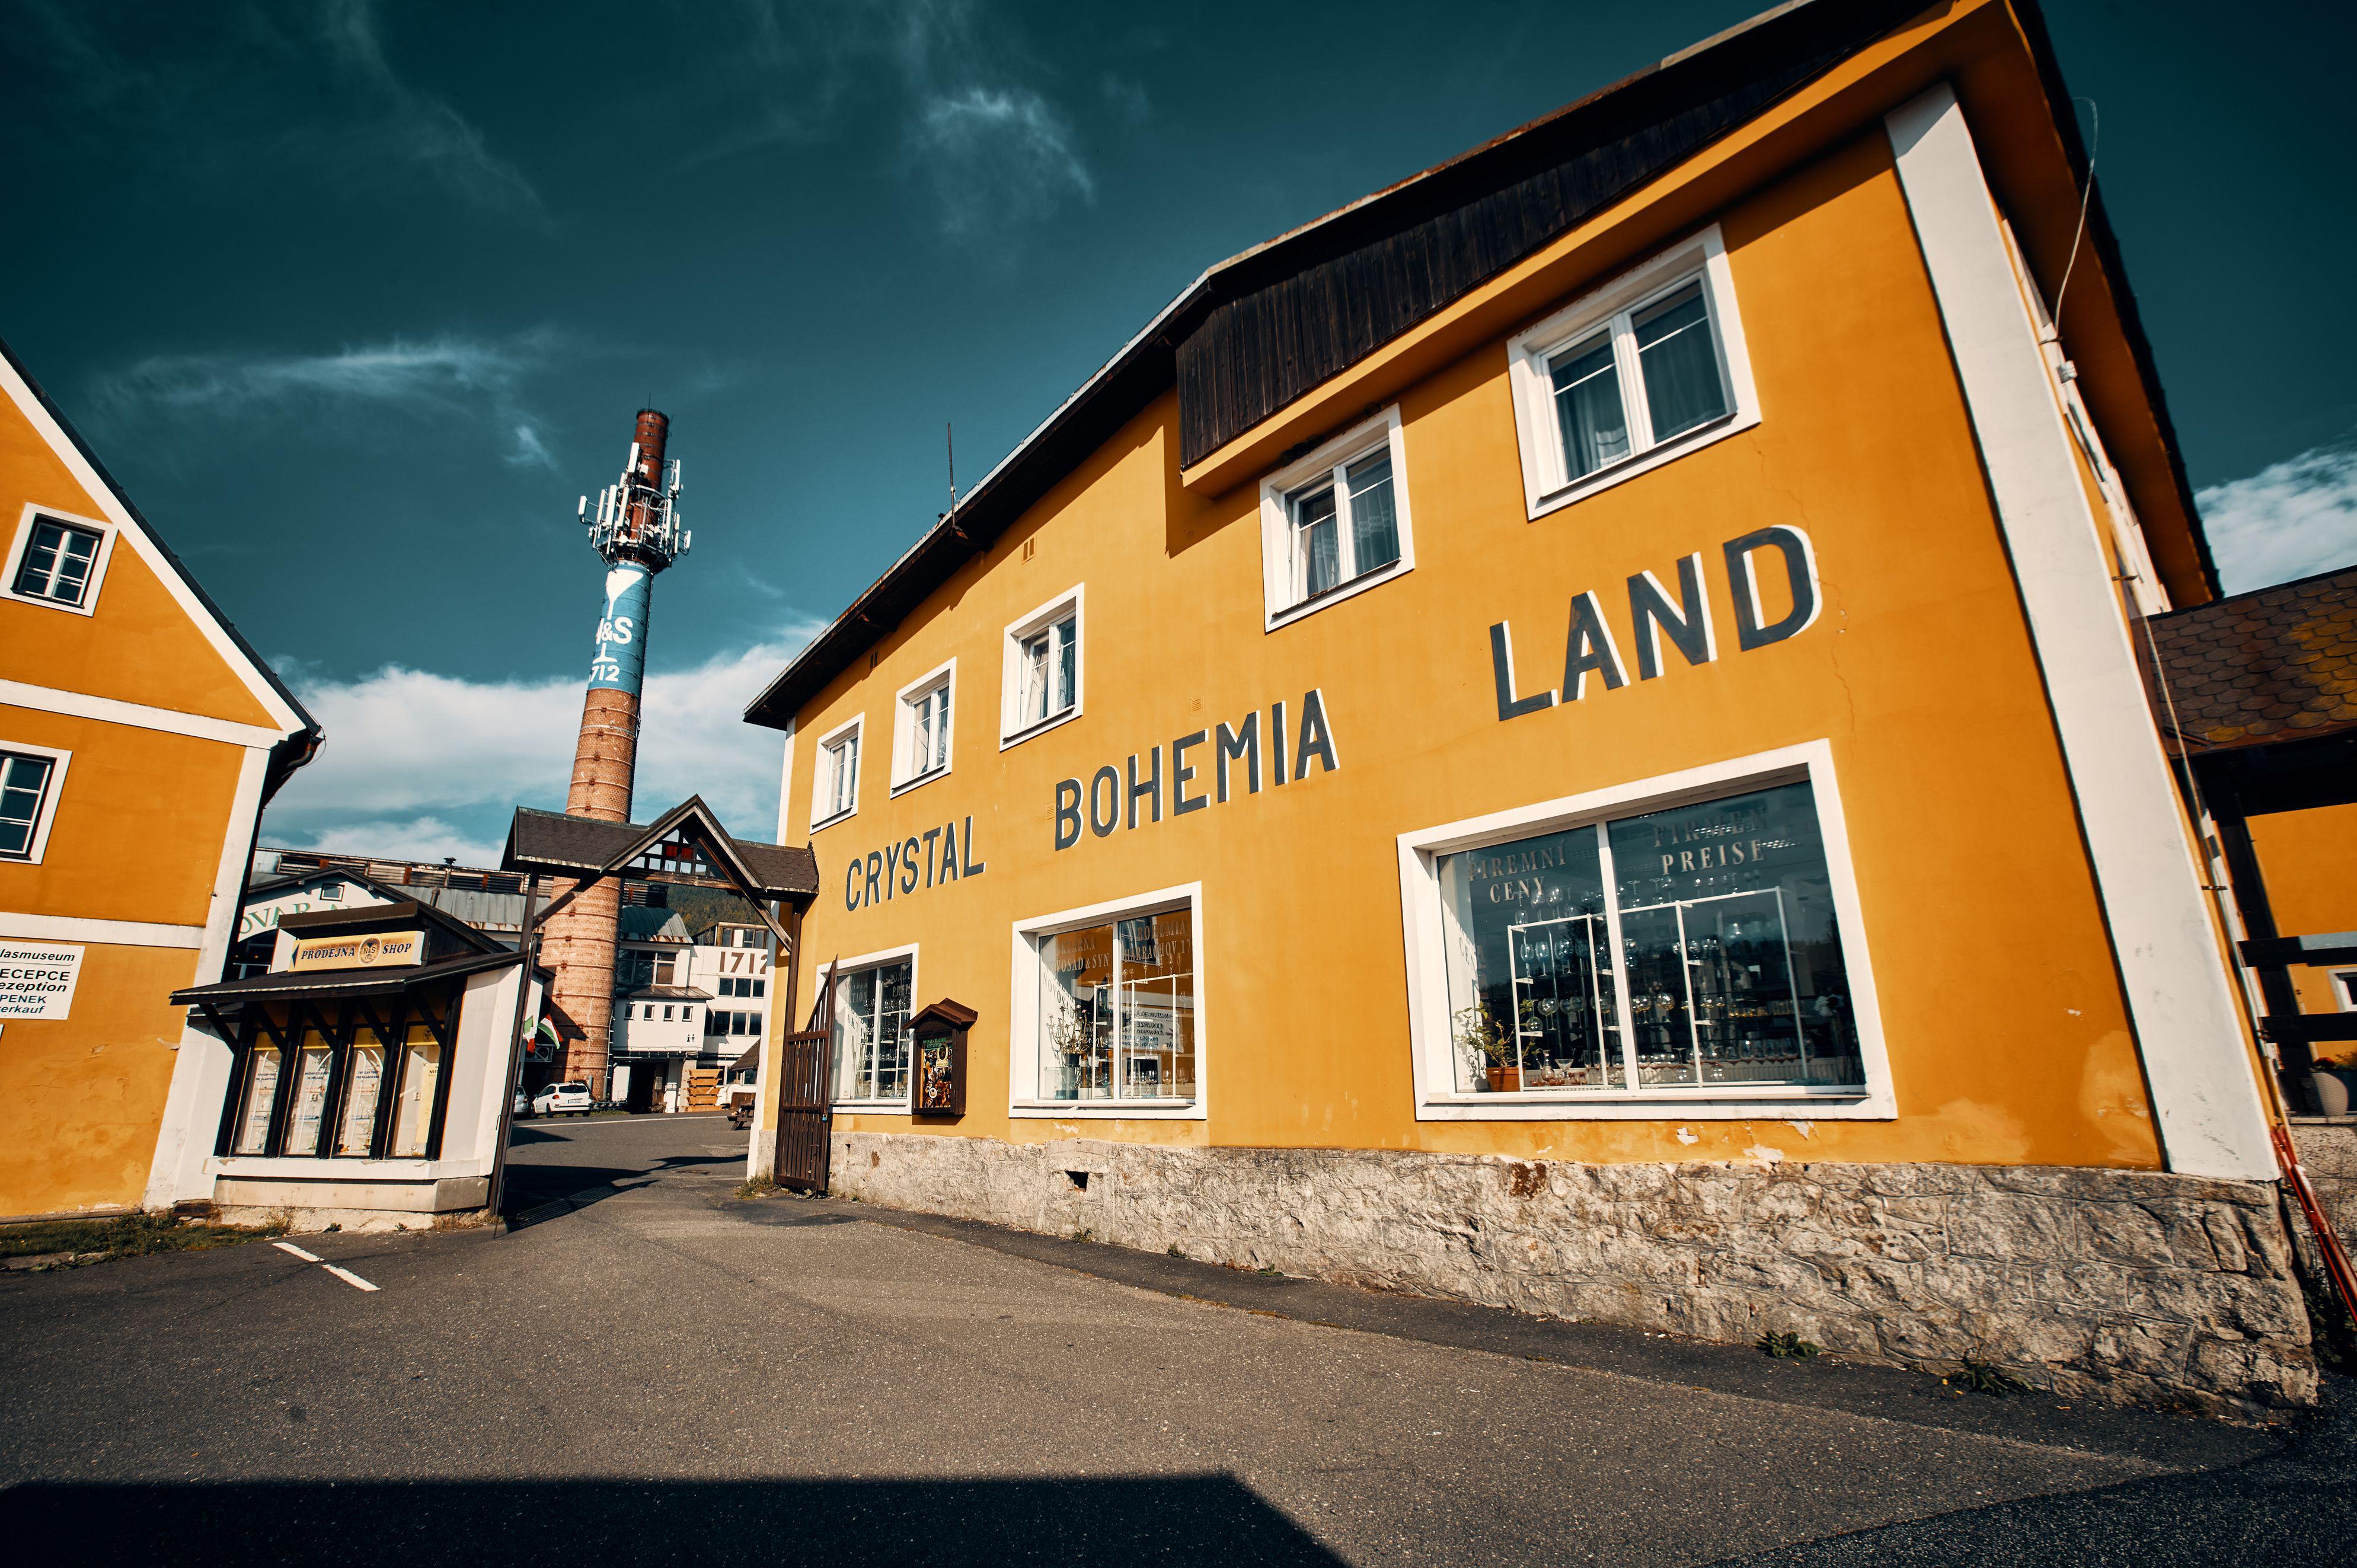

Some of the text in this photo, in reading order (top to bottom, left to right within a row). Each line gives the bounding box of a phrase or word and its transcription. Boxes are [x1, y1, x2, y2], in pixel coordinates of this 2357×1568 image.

[589, 665, 620, 682] 712
[846, 524, 1823, 912] CRYSTAL BOHEMIA LAND
[1652, 809, 1768, 848] FIRMEN
[1468, 838, 1568, 882] FIREMNÍ
[1660, 838, 1765, 876] PREISE
[1490, 876, 1545, 903] CENY
[1138, 921, 1186, 941] BOHEMIA
[301, 947, 355, 959] PRODEJNA
[382, 943, 411, 954] SHOP
[1123, 941, 1177, 962] HARRACHOV
[1093, 953, 1110, 969] SYN
